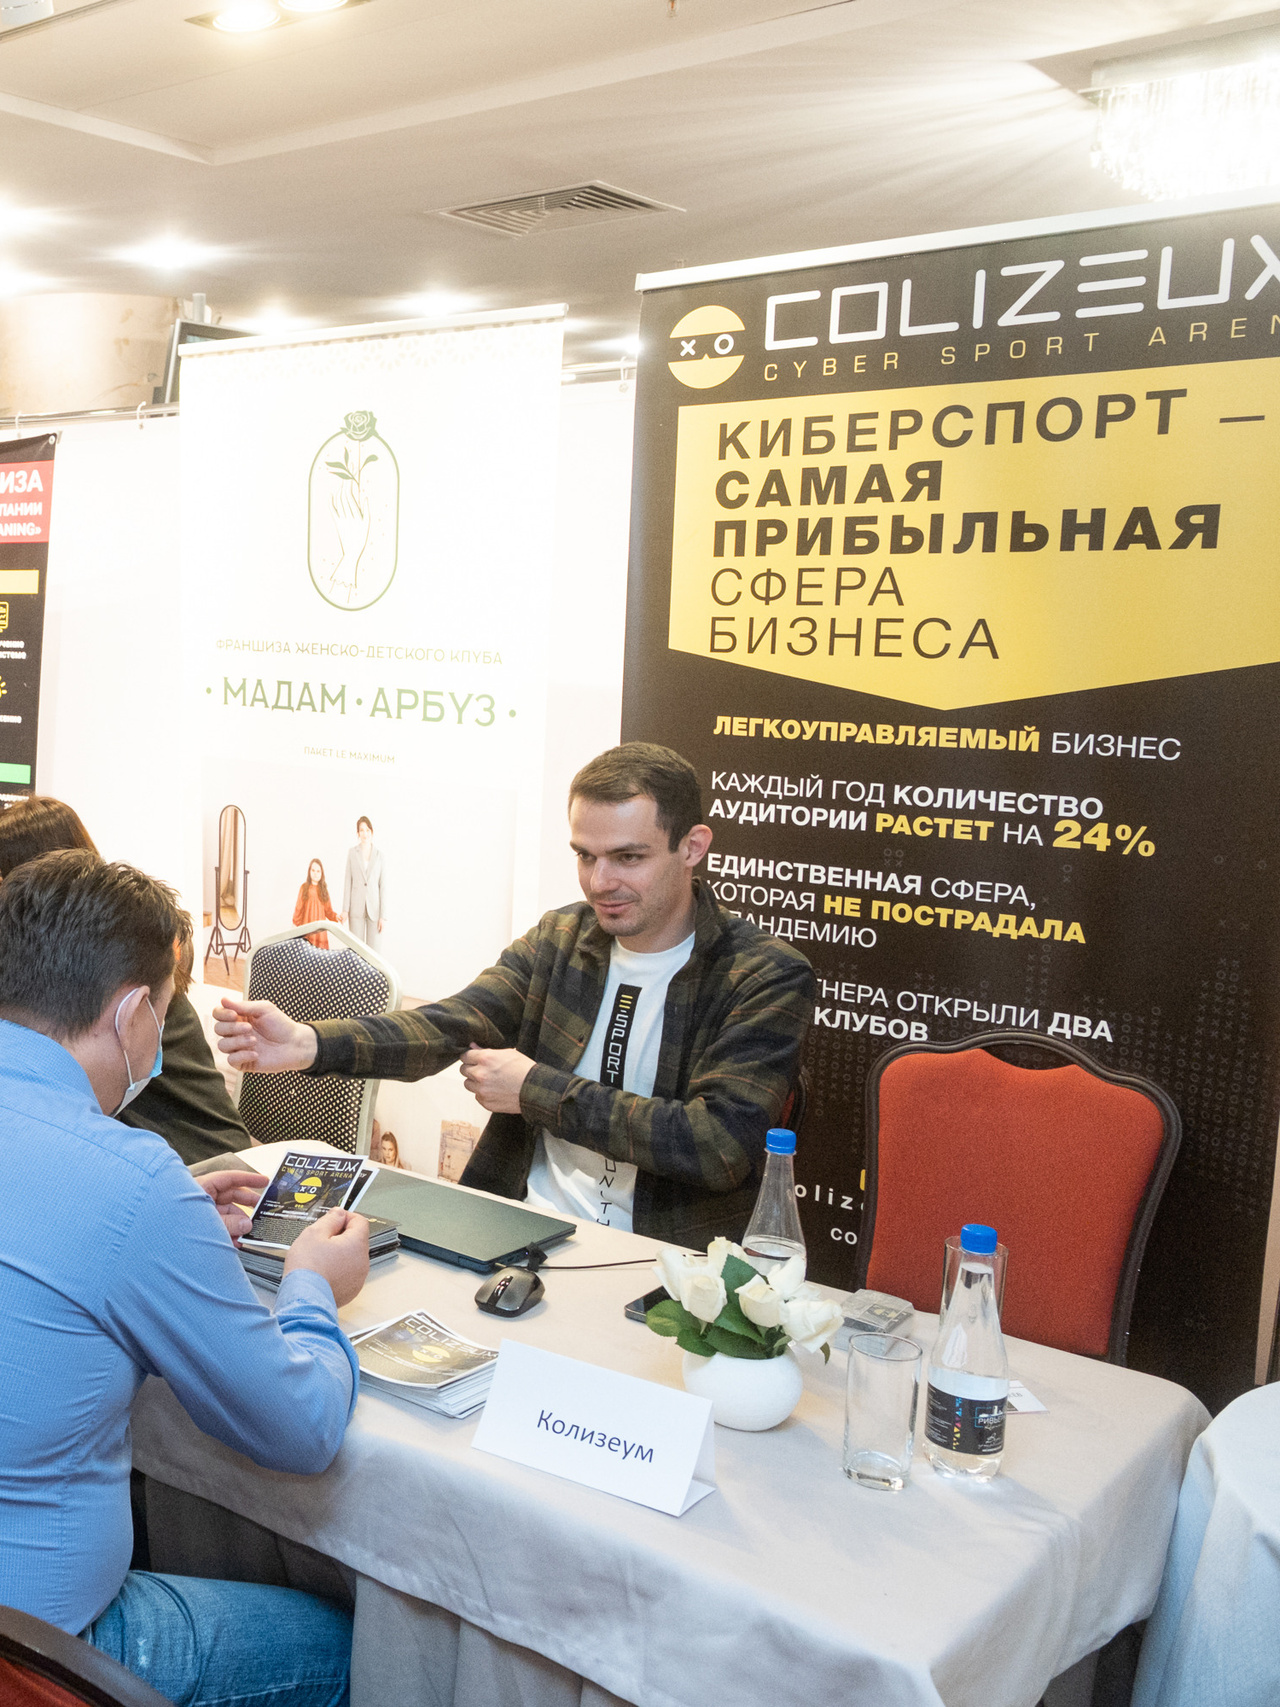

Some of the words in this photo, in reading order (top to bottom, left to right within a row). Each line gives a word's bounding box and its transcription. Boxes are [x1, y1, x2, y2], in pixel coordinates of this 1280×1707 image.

[764, 351, 899, 382] CYBER
[941, 332, 1100, 365] SPORT
[718, 388, 1187, 461] КИБЕРСПОРТ
[715, 460, 943, 509] САМАЯ
[713, 503, 1221, 557] ПРИБЫЛЬНАЯ
[711, 566, 905, 607] СФЕРА
[216, 639, 291, 654] ФРАНШИЗА
[295, 642, 445, 662] ЖЕНСКО-ДЕТСКОГО
[451, 650, 503, 665] КЛУБА
[709, 616, 1000, 660] БИЗНЕСА
[223, 676, 346, 716] МАДАМ
[369, 687, 496, 727] АРБУЗ
[713, 715, 1040, 753] ЛЕГКОУПРАВЛЯЕМЫЙ
[1051, 731, 1181, 762] БИЗНЕС
[711, 771, 822, 799] КАЖДЫЙ
[831, 780, 885, 808] ГОД
[893, 784, 1104, 820] КОЛИЧЕСТВО
[709, 799, 867, 832] АУДИТОРИИ
[875, 812, 995, 842] РАСТЕТ
[1002, 823, 1043, 847] НА
[1052, 819, 1156, 857] 24%
[707, 853, 921, 895] ЕДИНСТВЕННАЯ
[931, 877, 1036, 911] СФЕРА,
[707, 879, 815, 913] КОТОРАЯ
[824, 894, 861, 918] НЕ
[871, 901, 1086, 944] ПОСТРАДАЛА
[814, 1007, 928, 1041] КЛУБОВ
[817, 978, 888, 1008] НЕРА
[896, 990, 1039, 1029] ОТКРЫЛИ
[1047, 1012, 1114, 1042] ДВА
[537, 1409, 654, 1463] Колизеум
